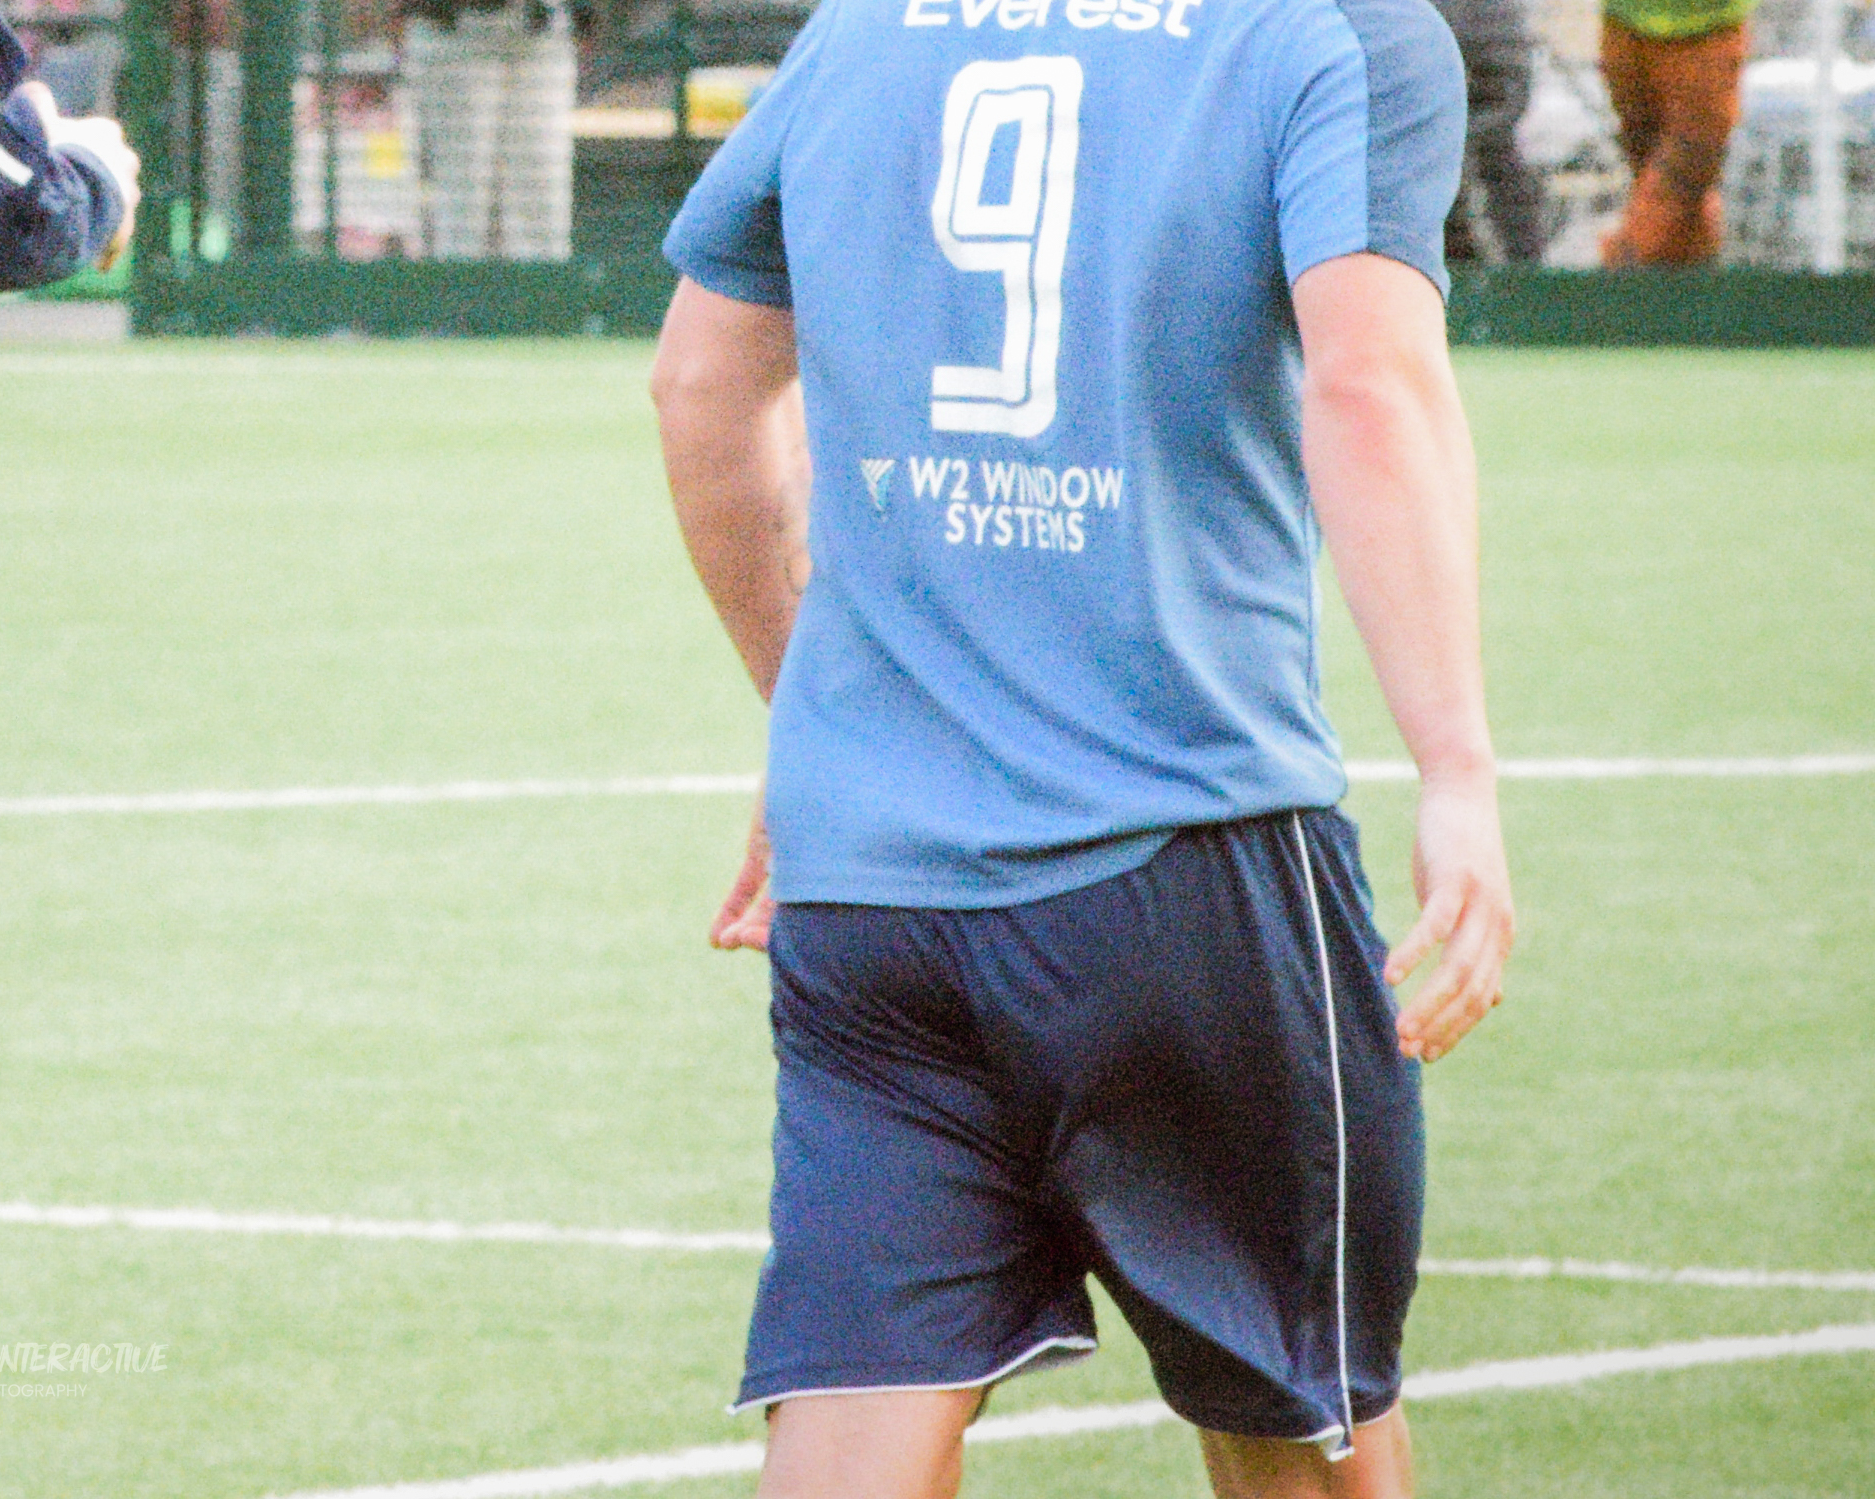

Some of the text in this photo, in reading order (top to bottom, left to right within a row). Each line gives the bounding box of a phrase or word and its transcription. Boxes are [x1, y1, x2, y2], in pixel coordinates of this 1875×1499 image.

[931, 55, 1084, 438] 9
[909, 456, 1123, 509] W2 WINDOW
[945, 502, 1085, 553] SYSTEMS
